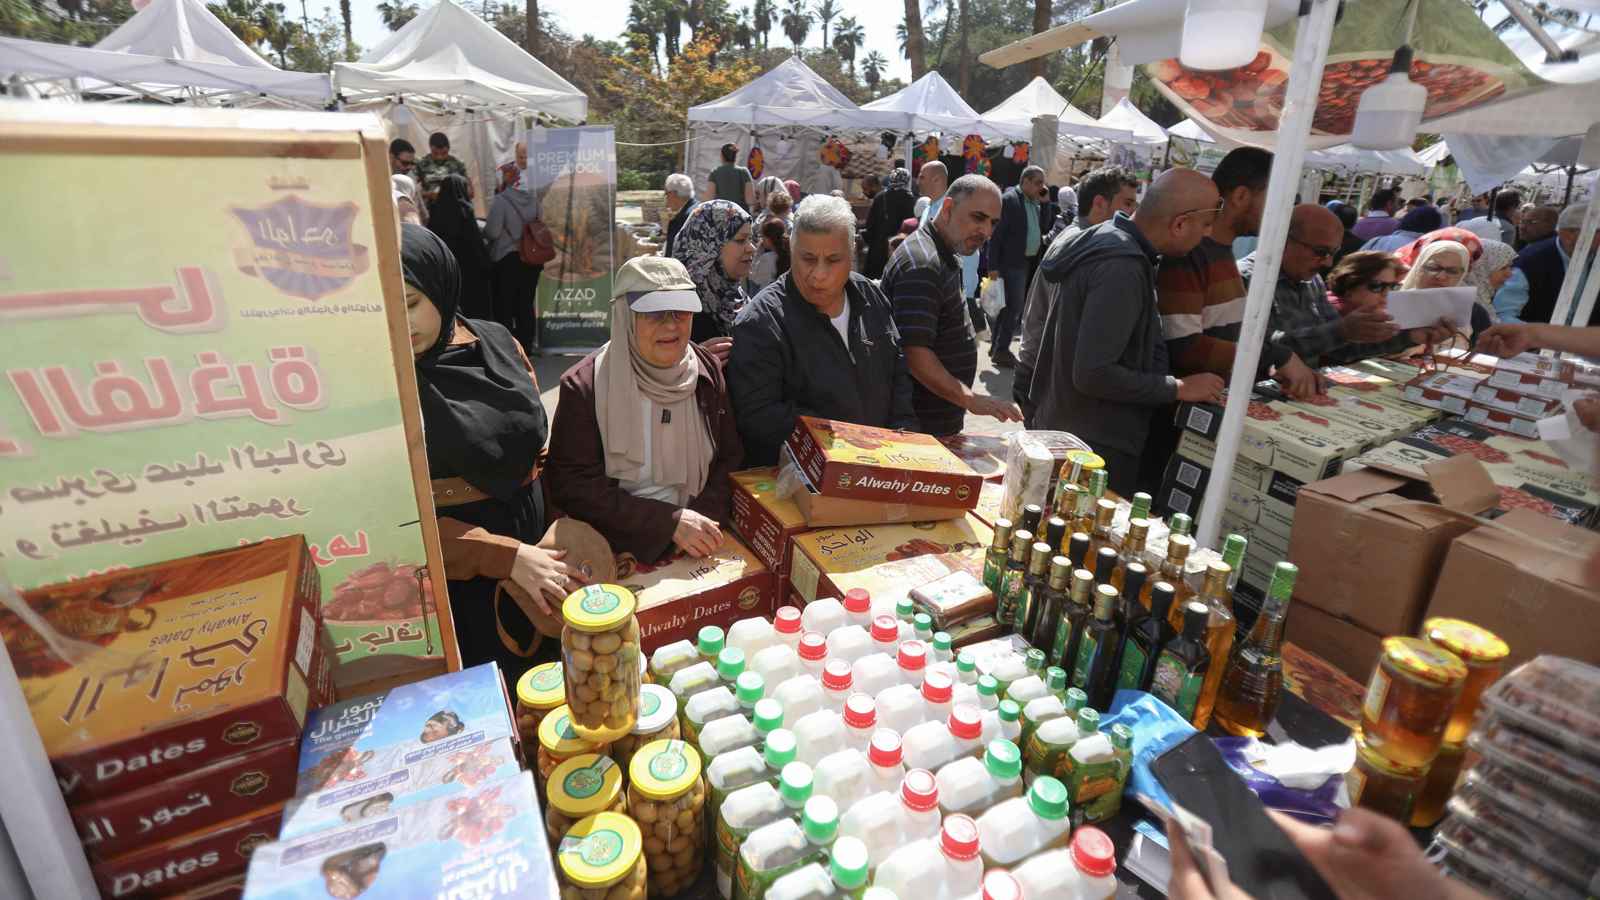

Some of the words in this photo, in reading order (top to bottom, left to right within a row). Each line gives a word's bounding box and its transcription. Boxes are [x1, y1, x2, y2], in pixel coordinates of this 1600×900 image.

[536, 148, 605, 164] PREMIUM
[553, 287, 596, 301] AZAD
[855, 475, 909, 493] Alwahy
[911, 481, 952, 496] Dates
[198, 611, 251, 636] Alwahy
[640, 614, 691, 639] Alwahy
[693, 600, 731, 620] Dates
[148, 627, 195, 648] Dates
[172, 659, 251, 712] تمور
[341, 695, 386, 720] تمور
[309, 709, 377, 739] الجنرال
[96, 738, 207, 781] Dates
[136, 792, 212, 833] تمور
[111, 851, 220, 898] Dates
